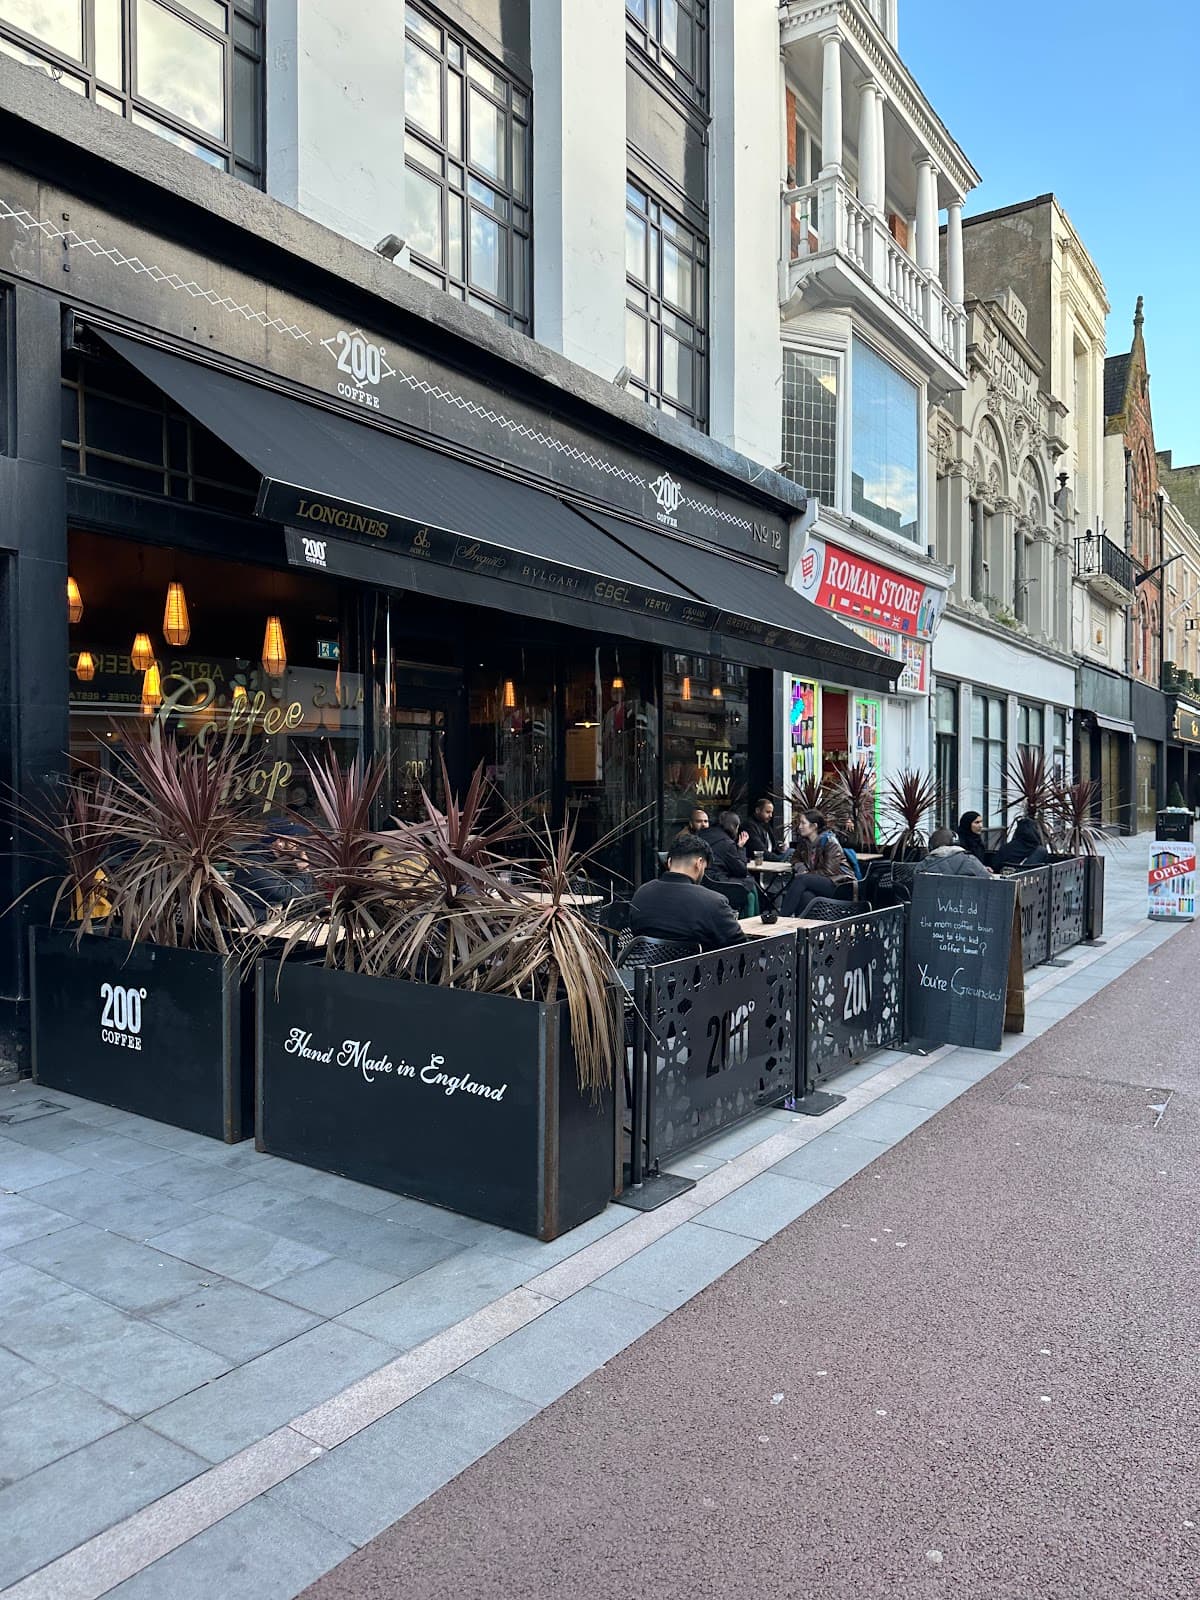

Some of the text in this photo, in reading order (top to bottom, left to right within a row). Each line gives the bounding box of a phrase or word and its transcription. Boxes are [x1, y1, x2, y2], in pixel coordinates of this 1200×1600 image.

[337, 382, 380, 409] COFFEE
[296, 500, 389, 539] LONGINES
[522, 565, 579, 589] BVLGARI
[826, 556, 920, 615] ROMAN STORE
[594, 582, 631, 604] EBEL
[644, 597, 671, 613] VERTU
[1153, 861, 1190, 881] OPEN
[938, 898, 978, 914] What did
[920, 916, 932, 927] the
[953, 920, 973, 931] coffee
[933, 932, 979, 945] say to the kid
[940, 942, 960, 954] coffee
[917, 963, 1002, 1001] You're Grounded
[101, 1028, 142, 1051] COFFEE
[284, 1027, 508, 1101] Hand Made in England
